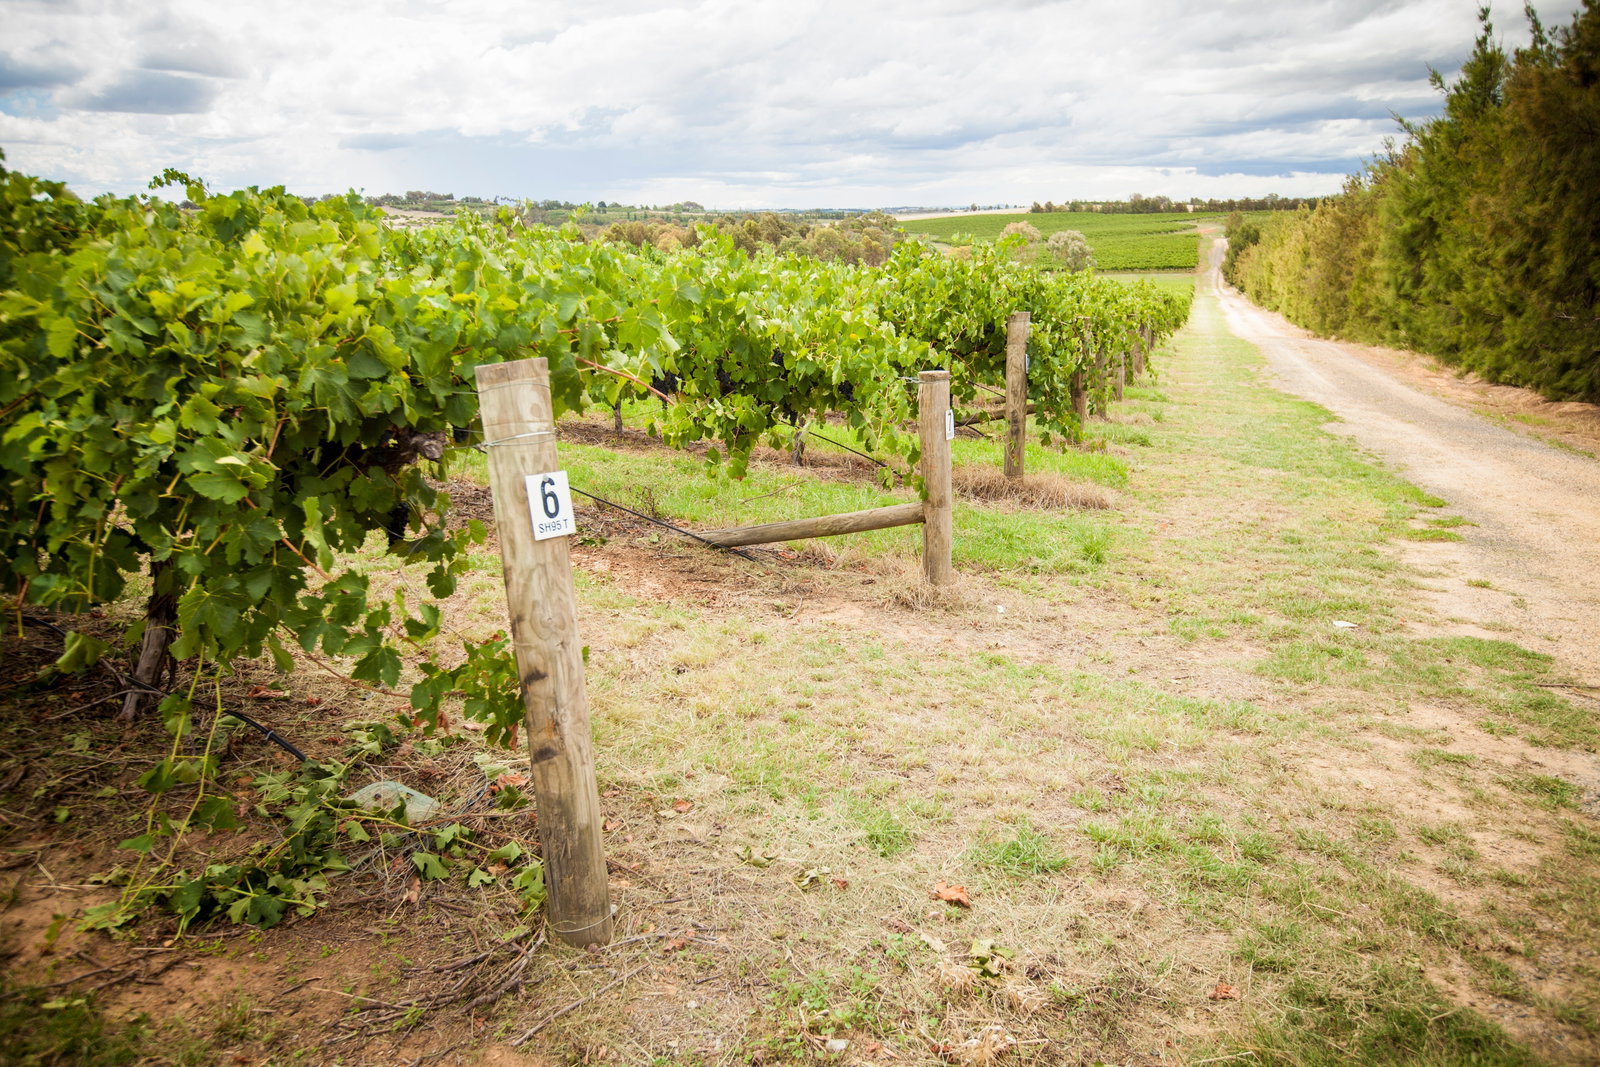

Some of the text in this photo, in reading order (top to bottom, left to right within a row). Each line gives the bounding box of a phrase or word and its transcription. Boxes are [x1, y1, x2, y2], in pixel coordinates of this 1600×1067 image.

[540, 476, 560, 519] 6
[538, 518, 568, 533] SH95 T
